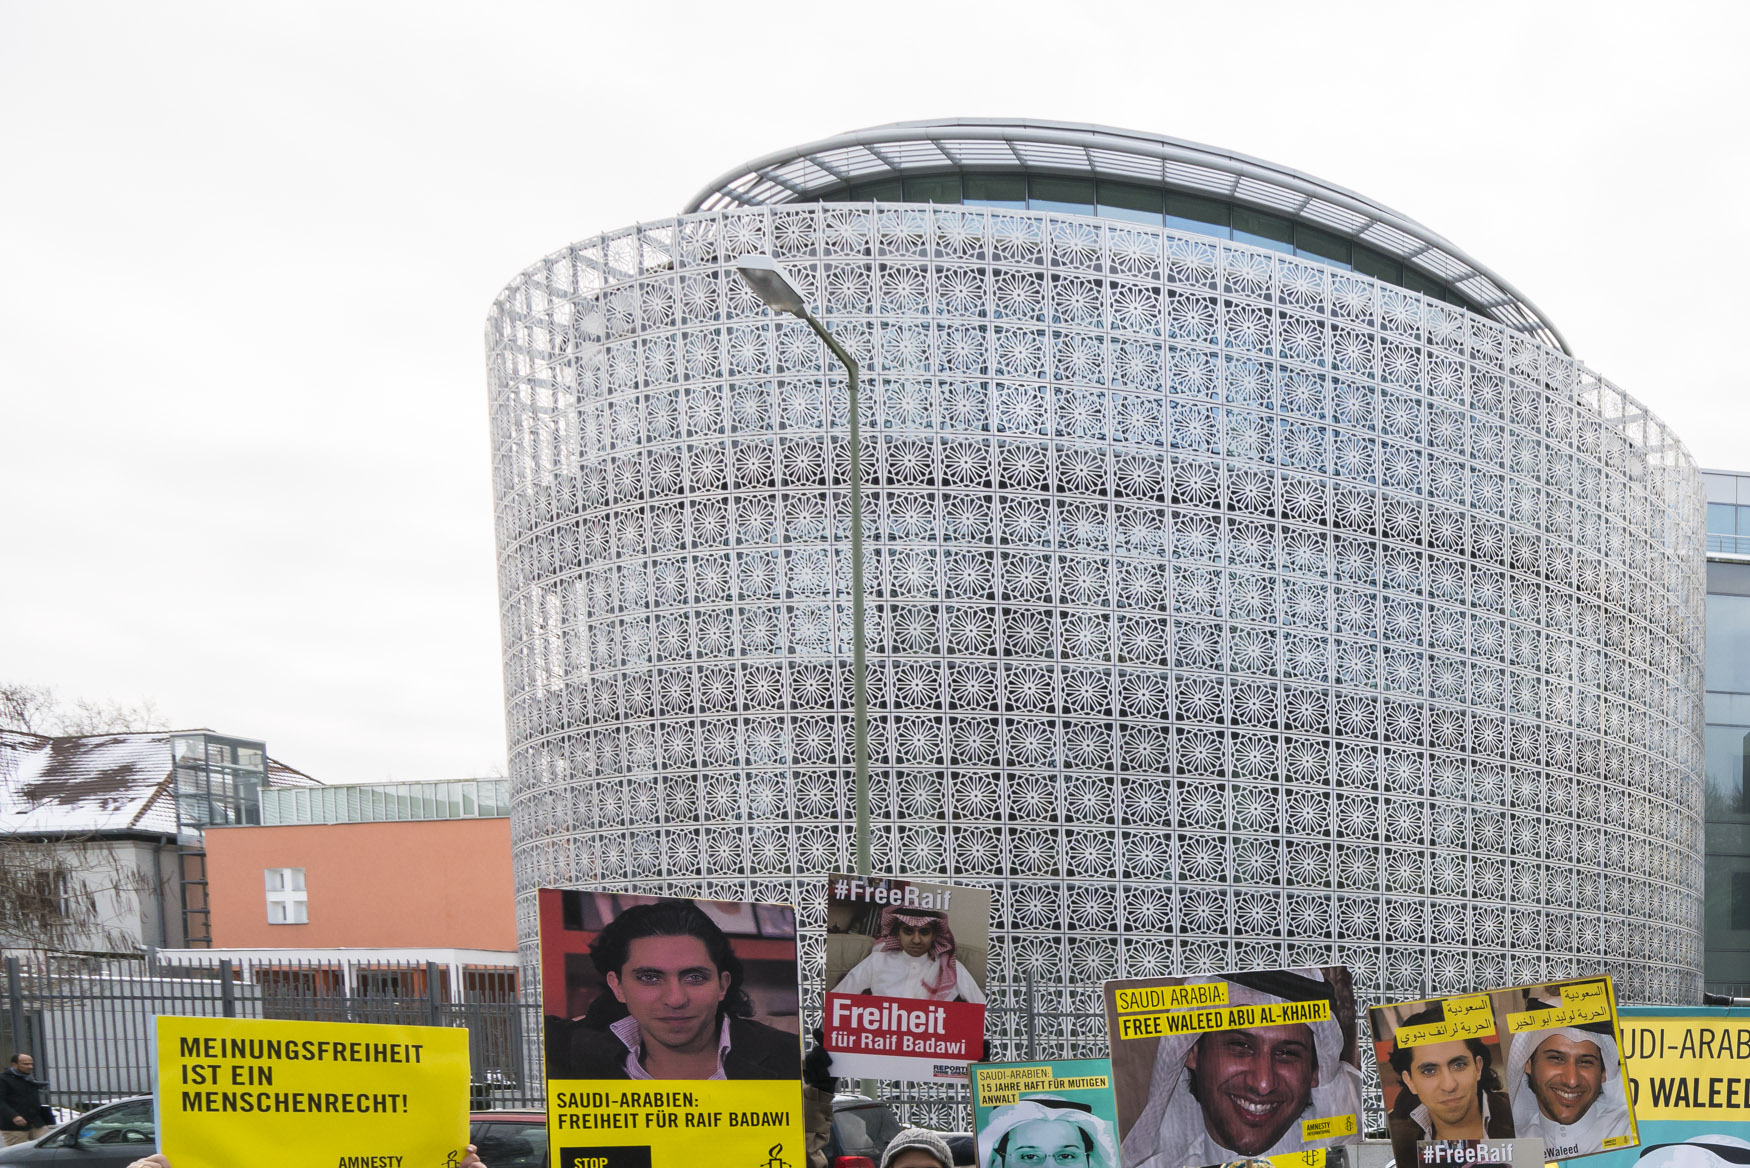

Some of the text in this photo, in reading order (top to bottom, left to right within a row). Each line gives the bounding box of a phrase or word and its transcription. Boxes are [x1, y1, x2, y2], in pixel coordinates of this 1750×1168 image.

[835, 879, 952, 910] #FreeRaif
[1119, 986, 1225, 1010] SAUDI ARABIA:
[833, 999, 945, 1034] Freiheit
[1123, 1005, 1327, 1036] FREE WALEED ABU AL-KHAIR!
[180, 1037, 423, 1063] MEINUNGSFREIHEIT
[832, 1032, 966, 1054] für Raif Badawi
[182, 1064, 273, 1086] IST EIN
[980, 1069, 1050, 1081] SAUDI-ARABIEN:
[982, 1078, 1106, 1092] 15 JAHRE HAFT FÜR MUTIGEN
[182, 1091, 408, 1113] MENSCHENRECHT!
[557, 1093, 698, 1108] SAUDI-ARABIEN:
[982, 1094, 1016, 1105] ANWALT
[558, 1110, 790, 1129] FREIHEIT FÜR RAIF BADAWI
[1307, 1122, 1330, 1131] AMNESTY
[338, 1156, 403, 1168] AMNESTY
[1424, 1143, 1513, 1163] #FreeRaif
